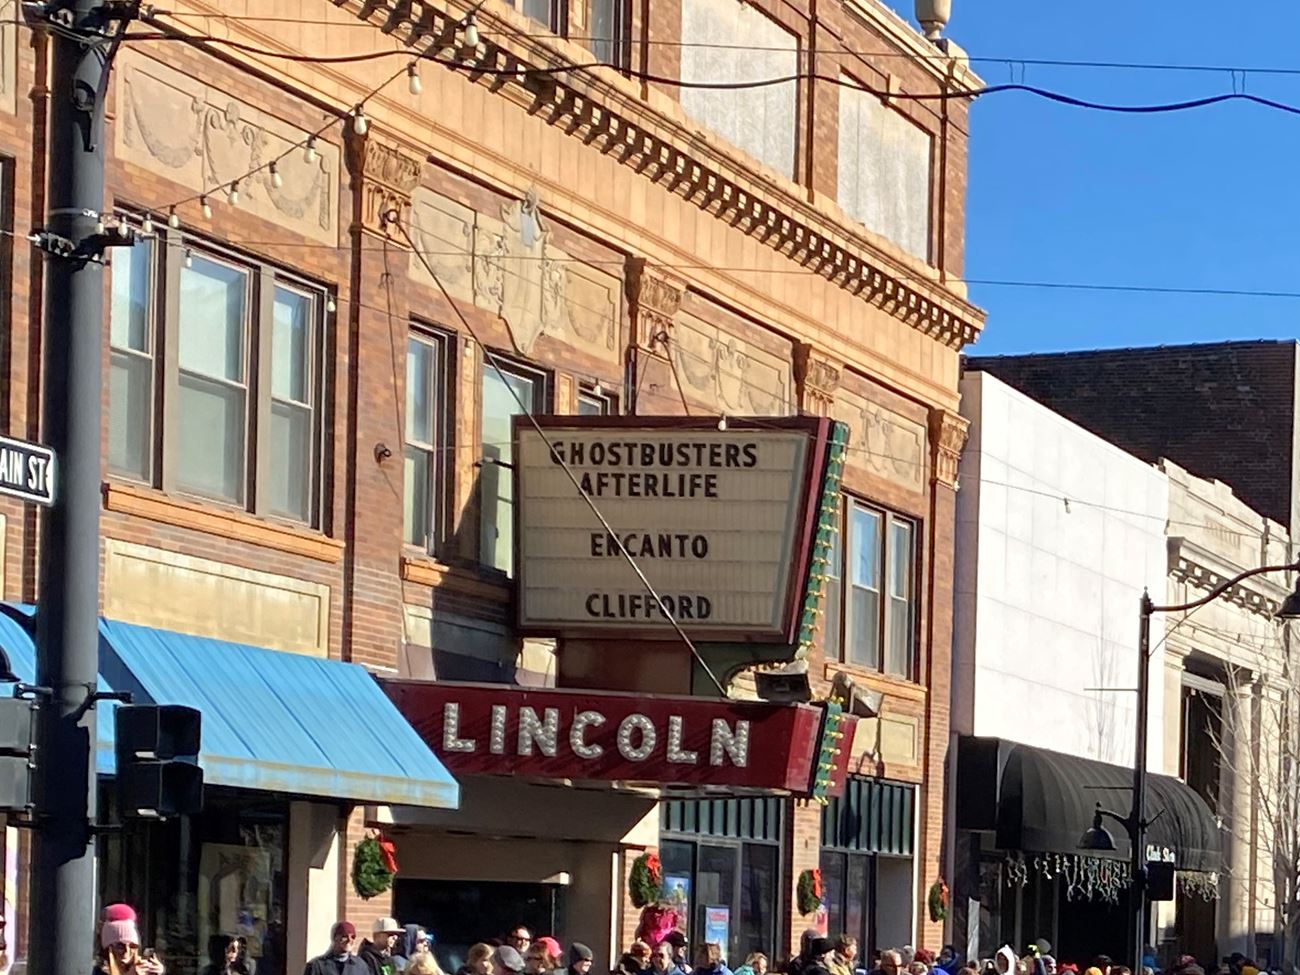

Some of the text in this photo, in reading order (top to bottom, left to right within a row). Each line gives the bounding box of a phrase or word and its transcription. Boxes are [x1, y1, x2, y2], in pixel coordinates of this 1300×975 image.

[550, 441, 757, 468] GHOSTBUSTERS
[0, 448, 46, 491] AIN ST
[579, 472, 718, 498] AFTERLIFE
[590, 533, 708, 558] ENCANTO
[585, 593, 711, 619] CLIFFORD
[443, 702, 750, 767] LINCOLN
